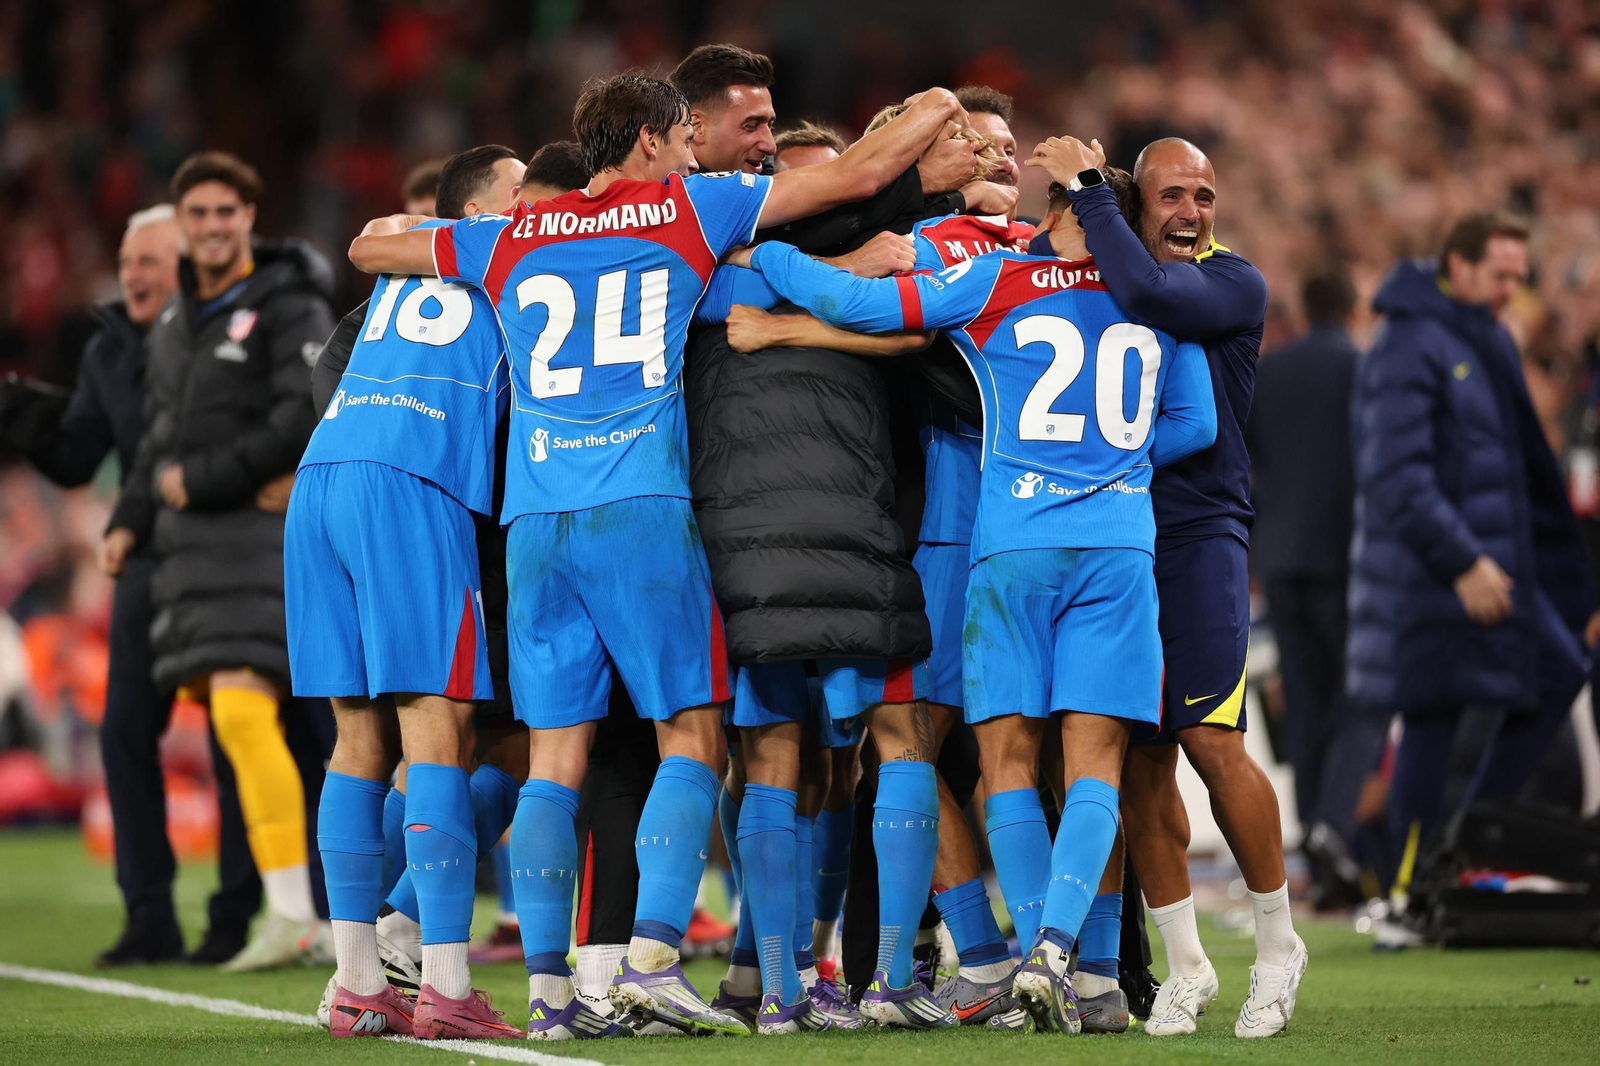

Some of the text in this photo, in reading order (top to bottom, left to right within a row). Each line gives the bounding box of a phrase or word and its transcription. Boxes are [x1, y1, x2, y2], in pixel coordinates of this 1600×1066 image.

[513, 213, 537, 239] LE
[538, 197, 678, 236] NORMAND
[515, 268, 671, 399] 24
[1013, 314, 1163, 452] 20
[345, 392, 447, 421] Save the Children
[552, 436, 583, 450] Save
[585, 433, 608, 447] the
[407, 857, 459, 872] LETI
[1017, 899, 1045, 913] ATL
